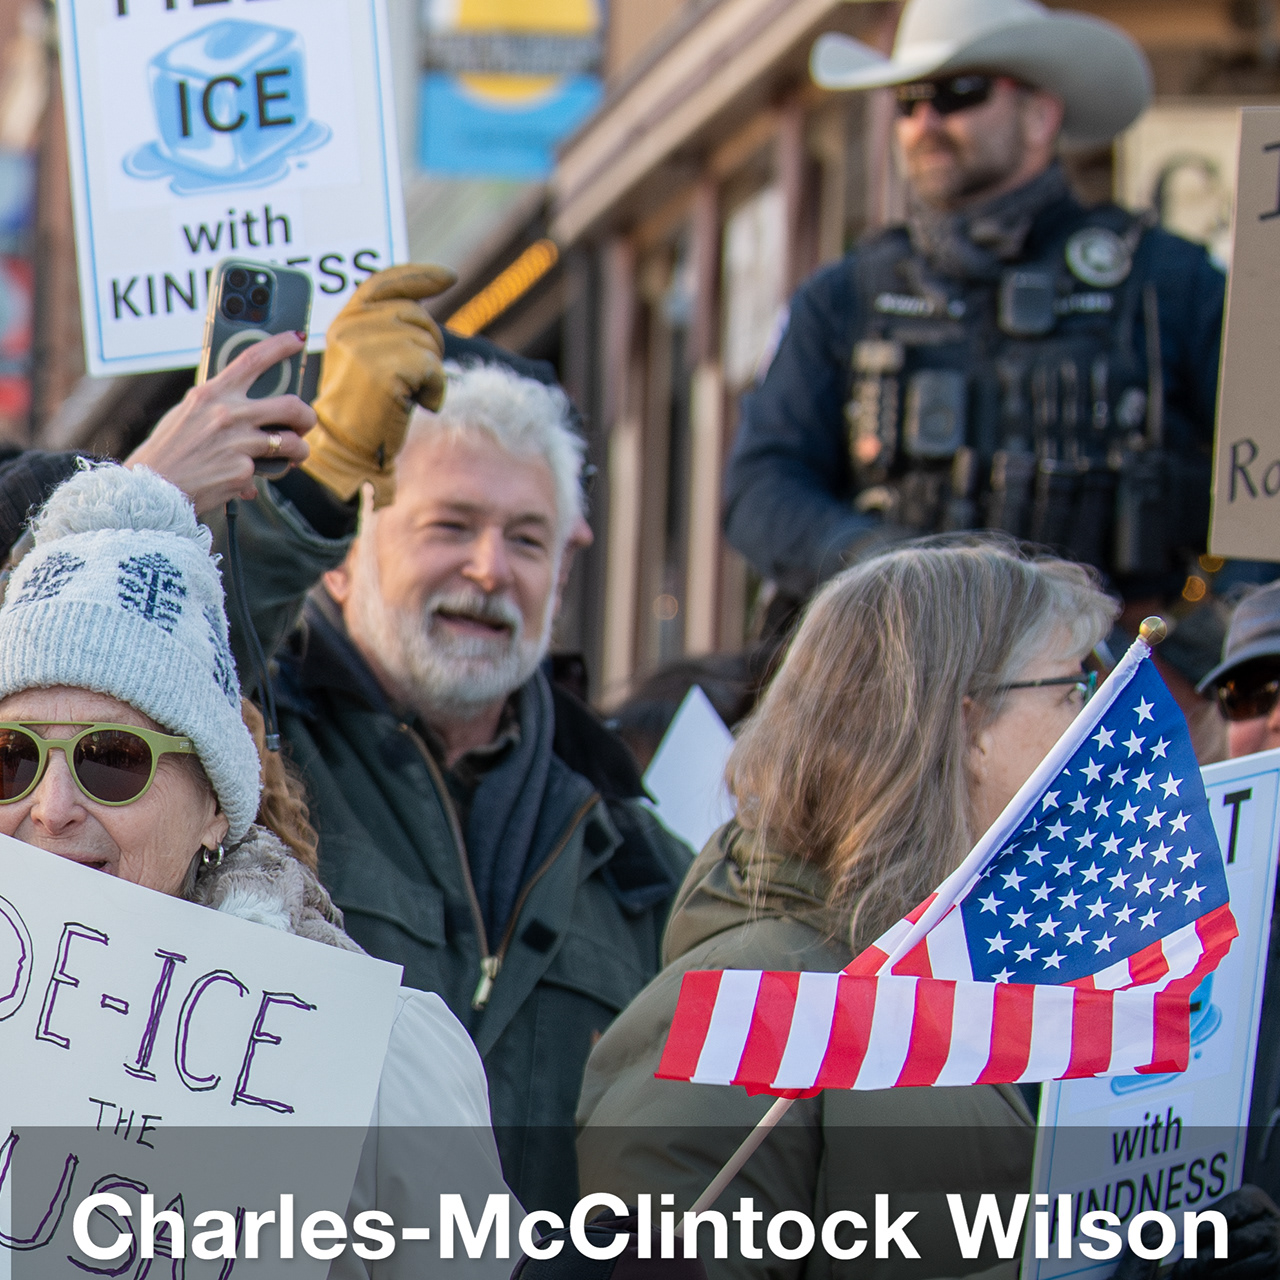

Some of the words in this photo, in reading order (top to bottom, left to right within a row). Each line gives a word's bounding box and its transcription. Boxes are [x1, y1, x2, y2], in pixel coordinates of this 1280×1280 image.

[178, 66, 296, 138] ICE
[183, 204, 291, 254] with
[111, 249, 381, 321] KINSS
[89, 1096, 162, 1150] THE
[1113, 1106, 1183, 1166] with
